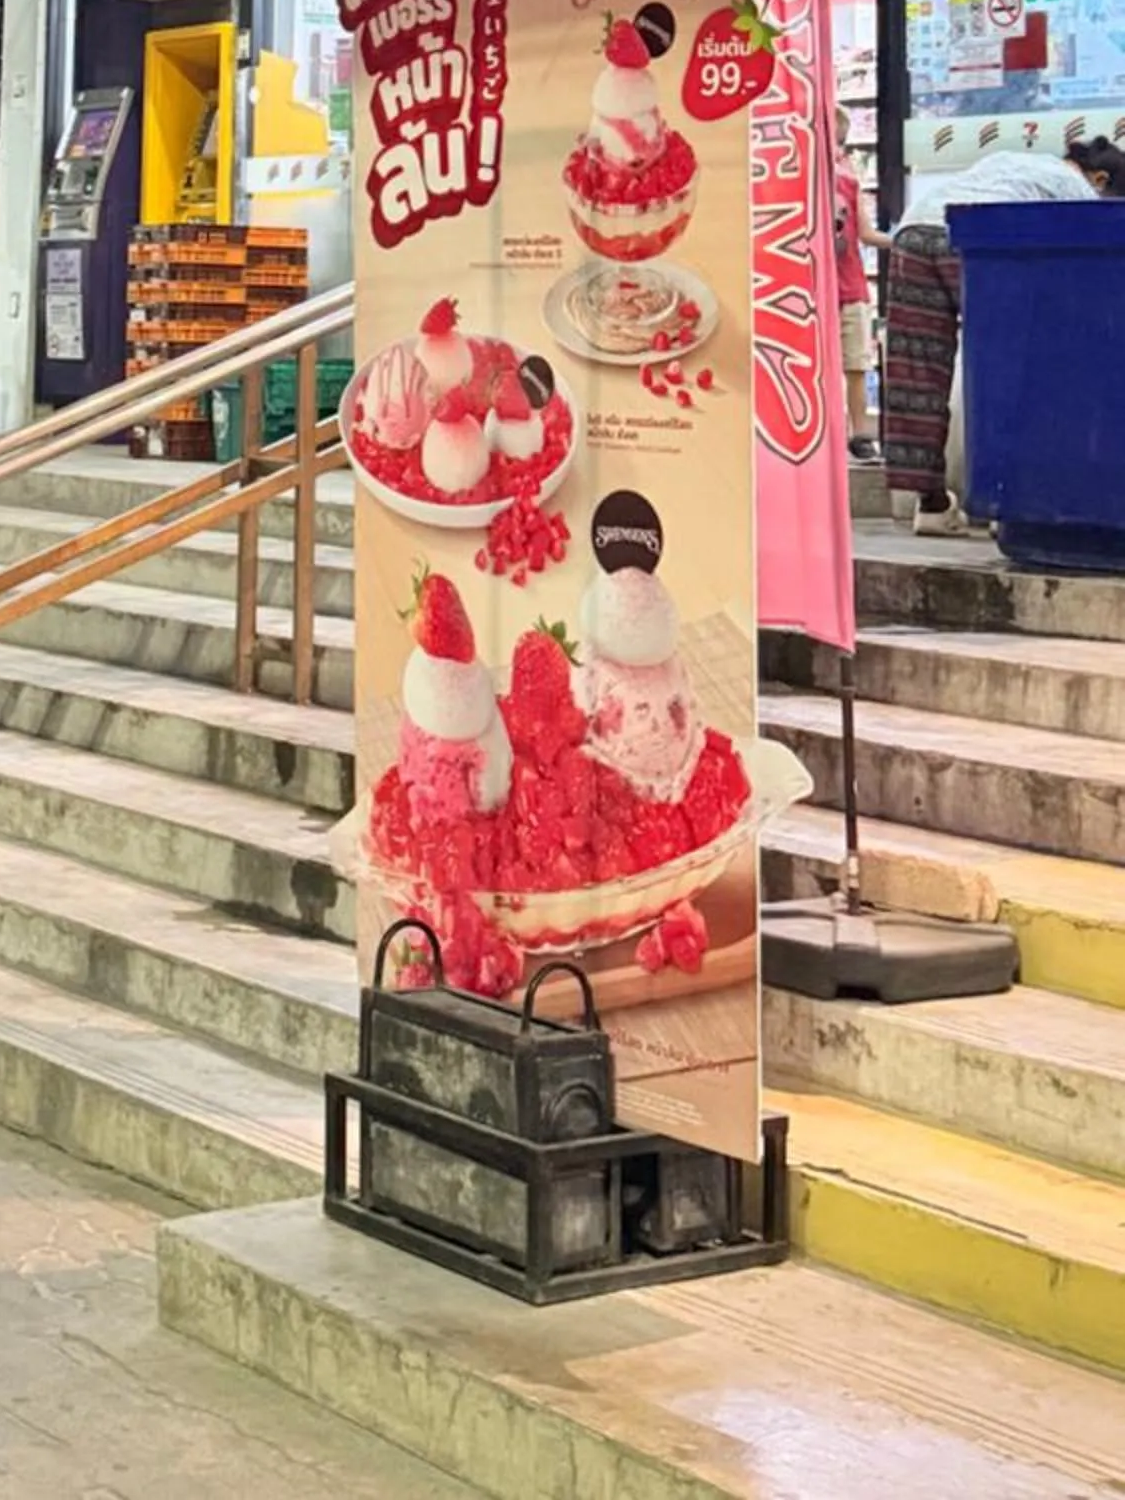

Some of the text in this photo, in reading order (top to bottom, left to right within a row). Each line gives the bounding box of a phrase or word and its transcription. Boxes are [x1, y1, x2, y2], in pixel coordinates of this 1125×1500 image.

[698, 31, 752, 59] เริ่มต้น
[379, 32, 463, 122] หน้า
[700, 61, 758, 98] 99.-
